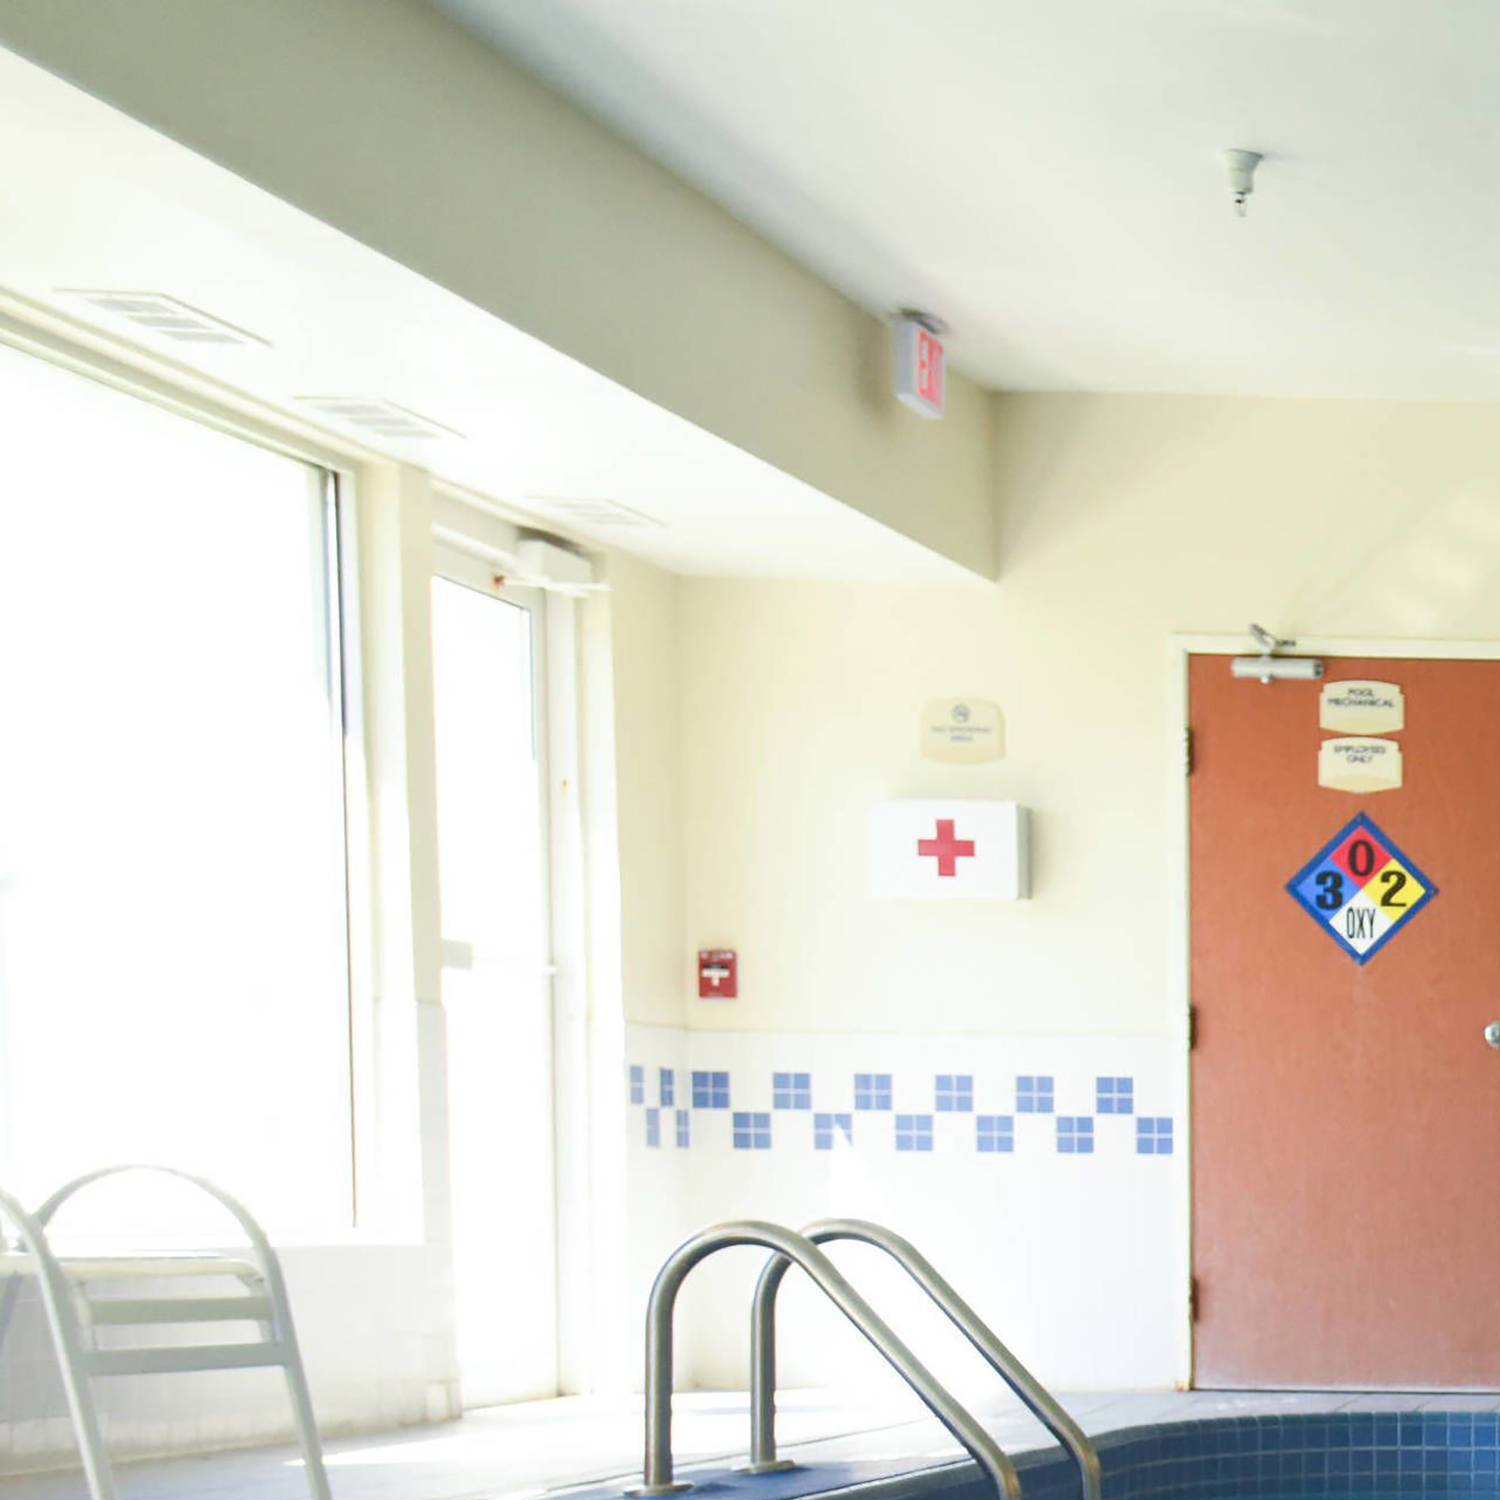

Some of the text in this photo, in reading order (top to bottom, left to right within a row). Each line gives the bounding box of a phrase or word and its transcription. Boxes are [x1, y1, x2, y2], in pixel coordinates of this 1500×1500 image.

[1348, 840, 1375, 877] 0
[1315, 870, 1343, 910] 3
[1380, 871, 1407, 907] 2
[1346, 907, 1376, 939] OXY
